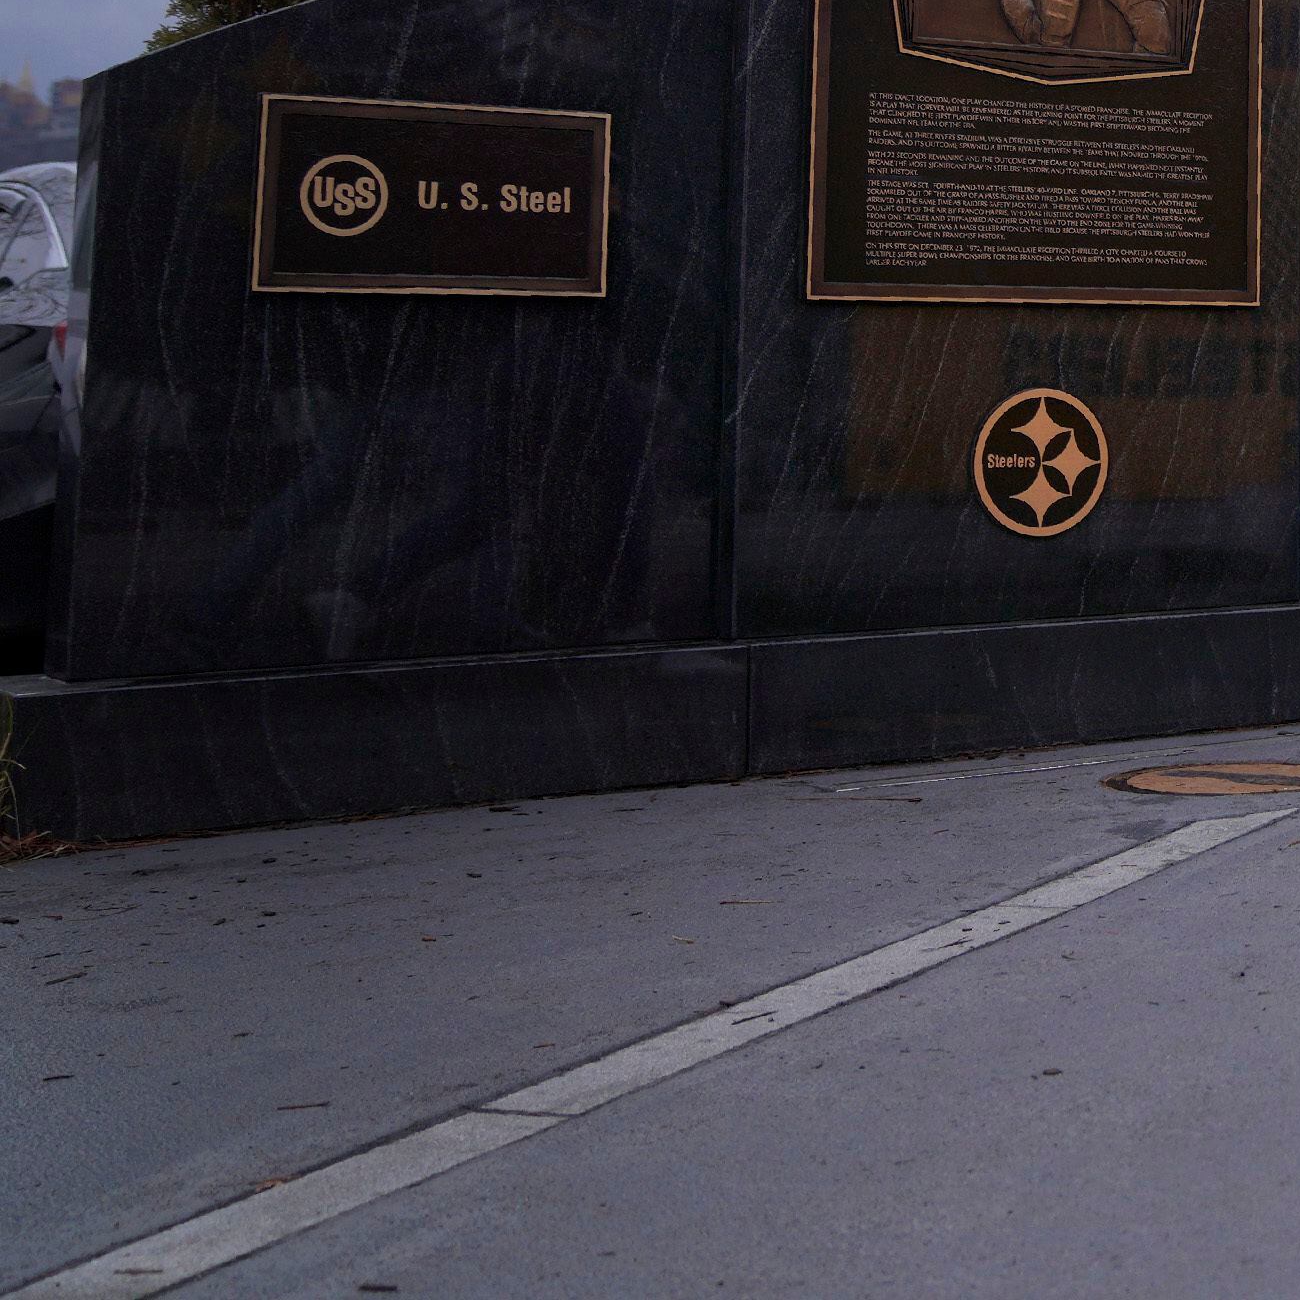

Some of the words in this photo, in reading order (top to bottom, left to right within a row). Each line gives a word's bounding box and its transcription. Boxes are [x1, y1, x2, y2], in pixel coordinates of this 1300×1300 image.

[417, 180, 448, 210] U.
[460, 182, 489, 211] S.
[499, 184, 571, 214] Steel
[987, 453, 1036, 469] Steelers
